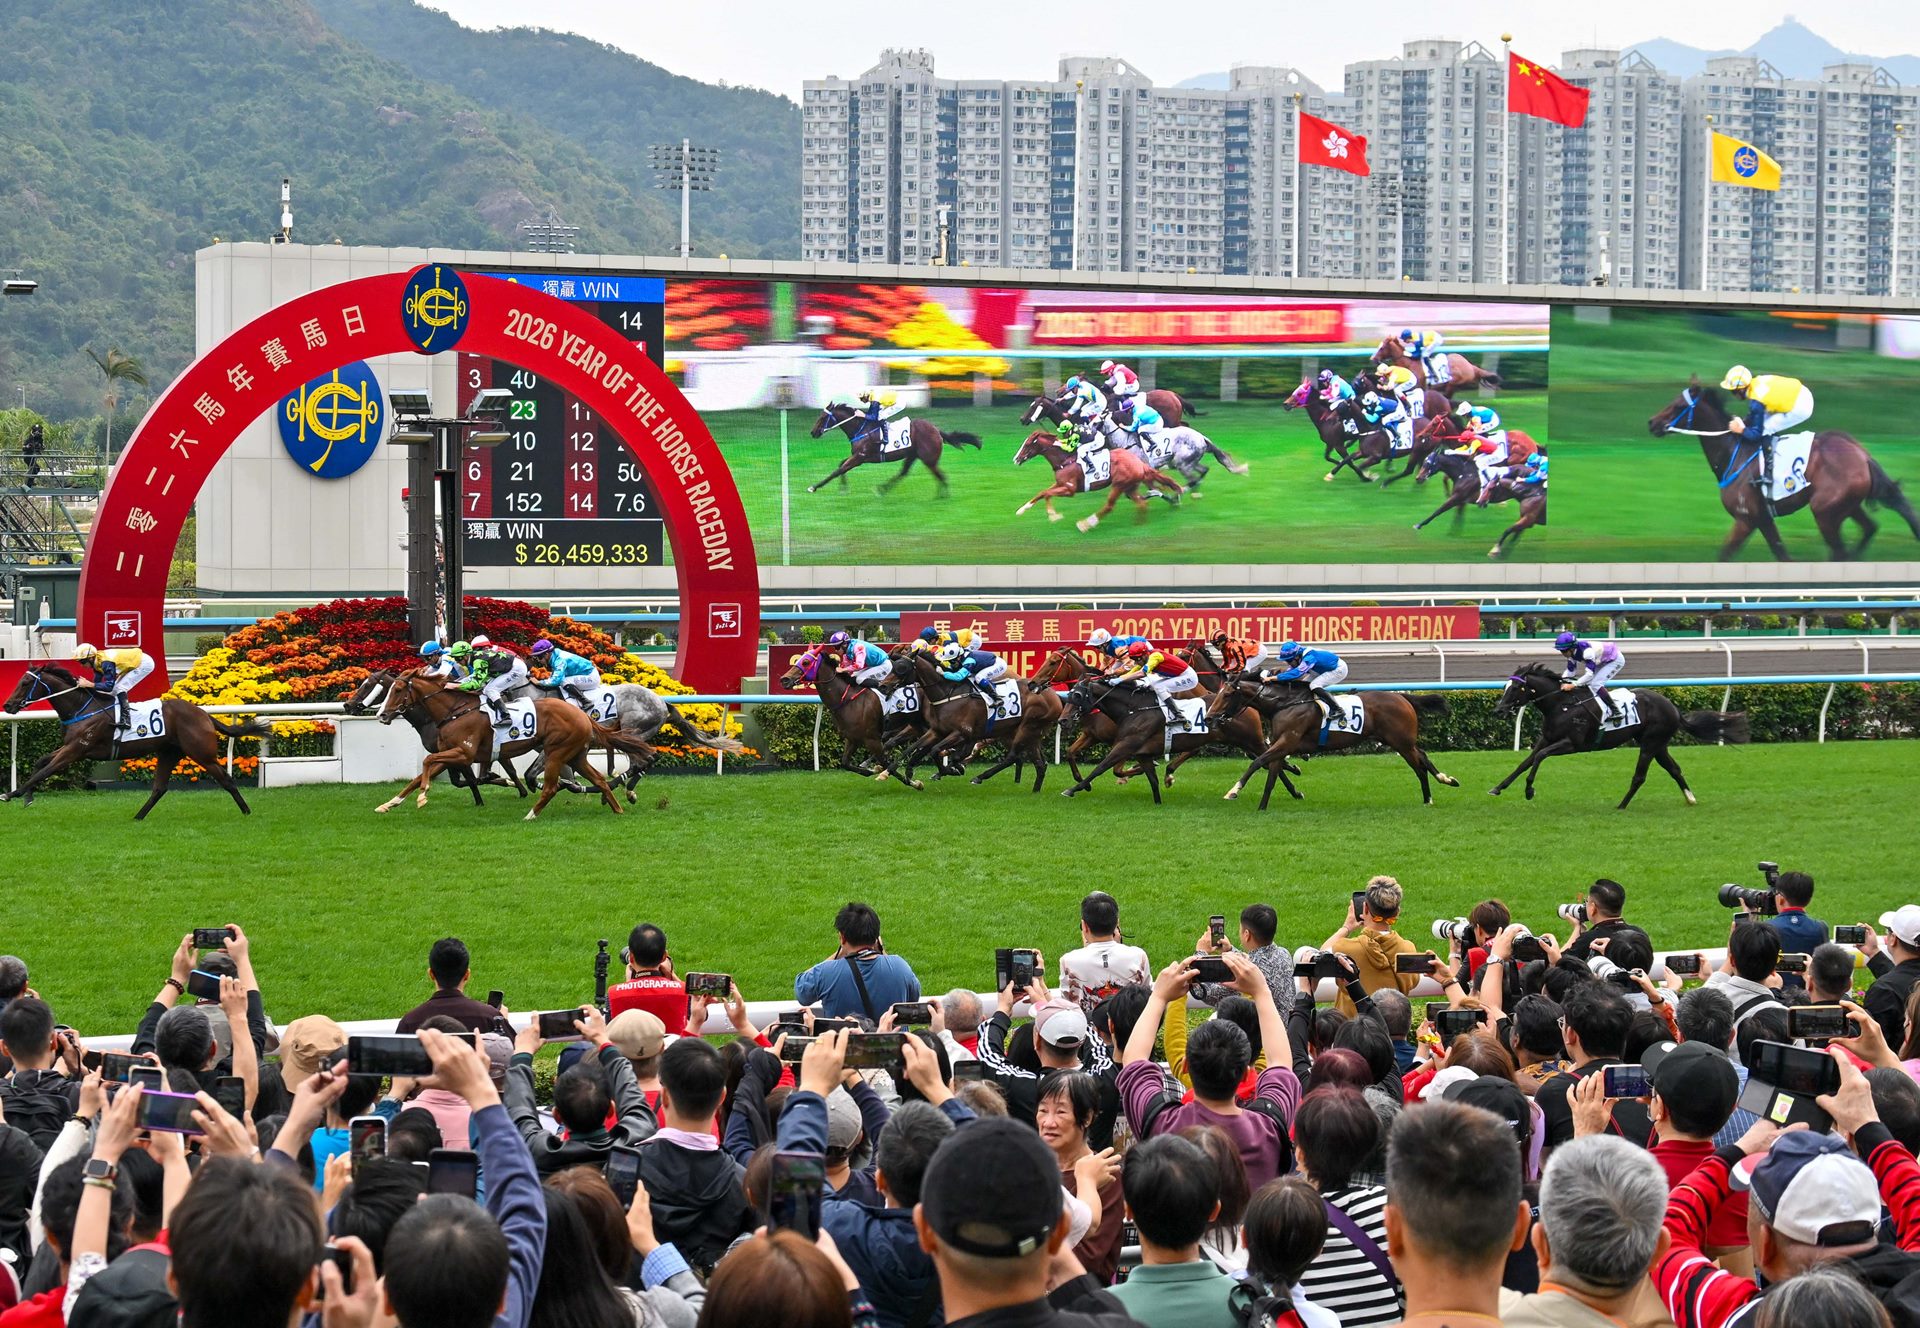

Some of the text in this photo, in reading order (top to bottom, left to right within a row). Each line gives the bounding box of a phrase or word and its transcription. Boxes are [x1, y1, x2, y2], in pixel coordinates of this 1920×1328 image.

[582, 282, 619, 298] WIN
[619, 311, 642, 330] 14
[468, 369, 536, 389] 3 40
[511, 401, 536, 420] 23
[503, 309, 734, 572] 2026 YEAR OF THE HORSE RACEDAY
[512, 431, 594, 451] 10 12
[1163, 437, 1172, 455] 2
[468, 462, 481, 481] 6
[510, 462, 533, 481] 21
[570, 462, 594, 481] 13
[468, 493, 645, 512] 7 152 14 7.6
[507, 523, 543, 539] WIN
[515, 543, 648, 566] $ 26,459,333
[1112, 618, 1164, 639] 2026
[1169, 617, 1221, 641] YEAR
[1227, 617, 1252, 639] OF
[1257, 616, 1294, 642] THE
[1301, 616, 1364, 641] HORSE
[1370, 615, 1456, 641] RACEDAY
[603, 692, 617, 719] 2
[902, 687, 917, 711] 8
[1008, 692, 1020, 716] 3
[150, 709, 164, 735] 6
[1194, 707, 1206, 732] 4
[1351, 705, 1362, 732] 5
[1621, 699, 1639, 725] 11
[523, 712, 535, 737] 9
[616, 980, 681, 991] PHOTOGRAPHER
